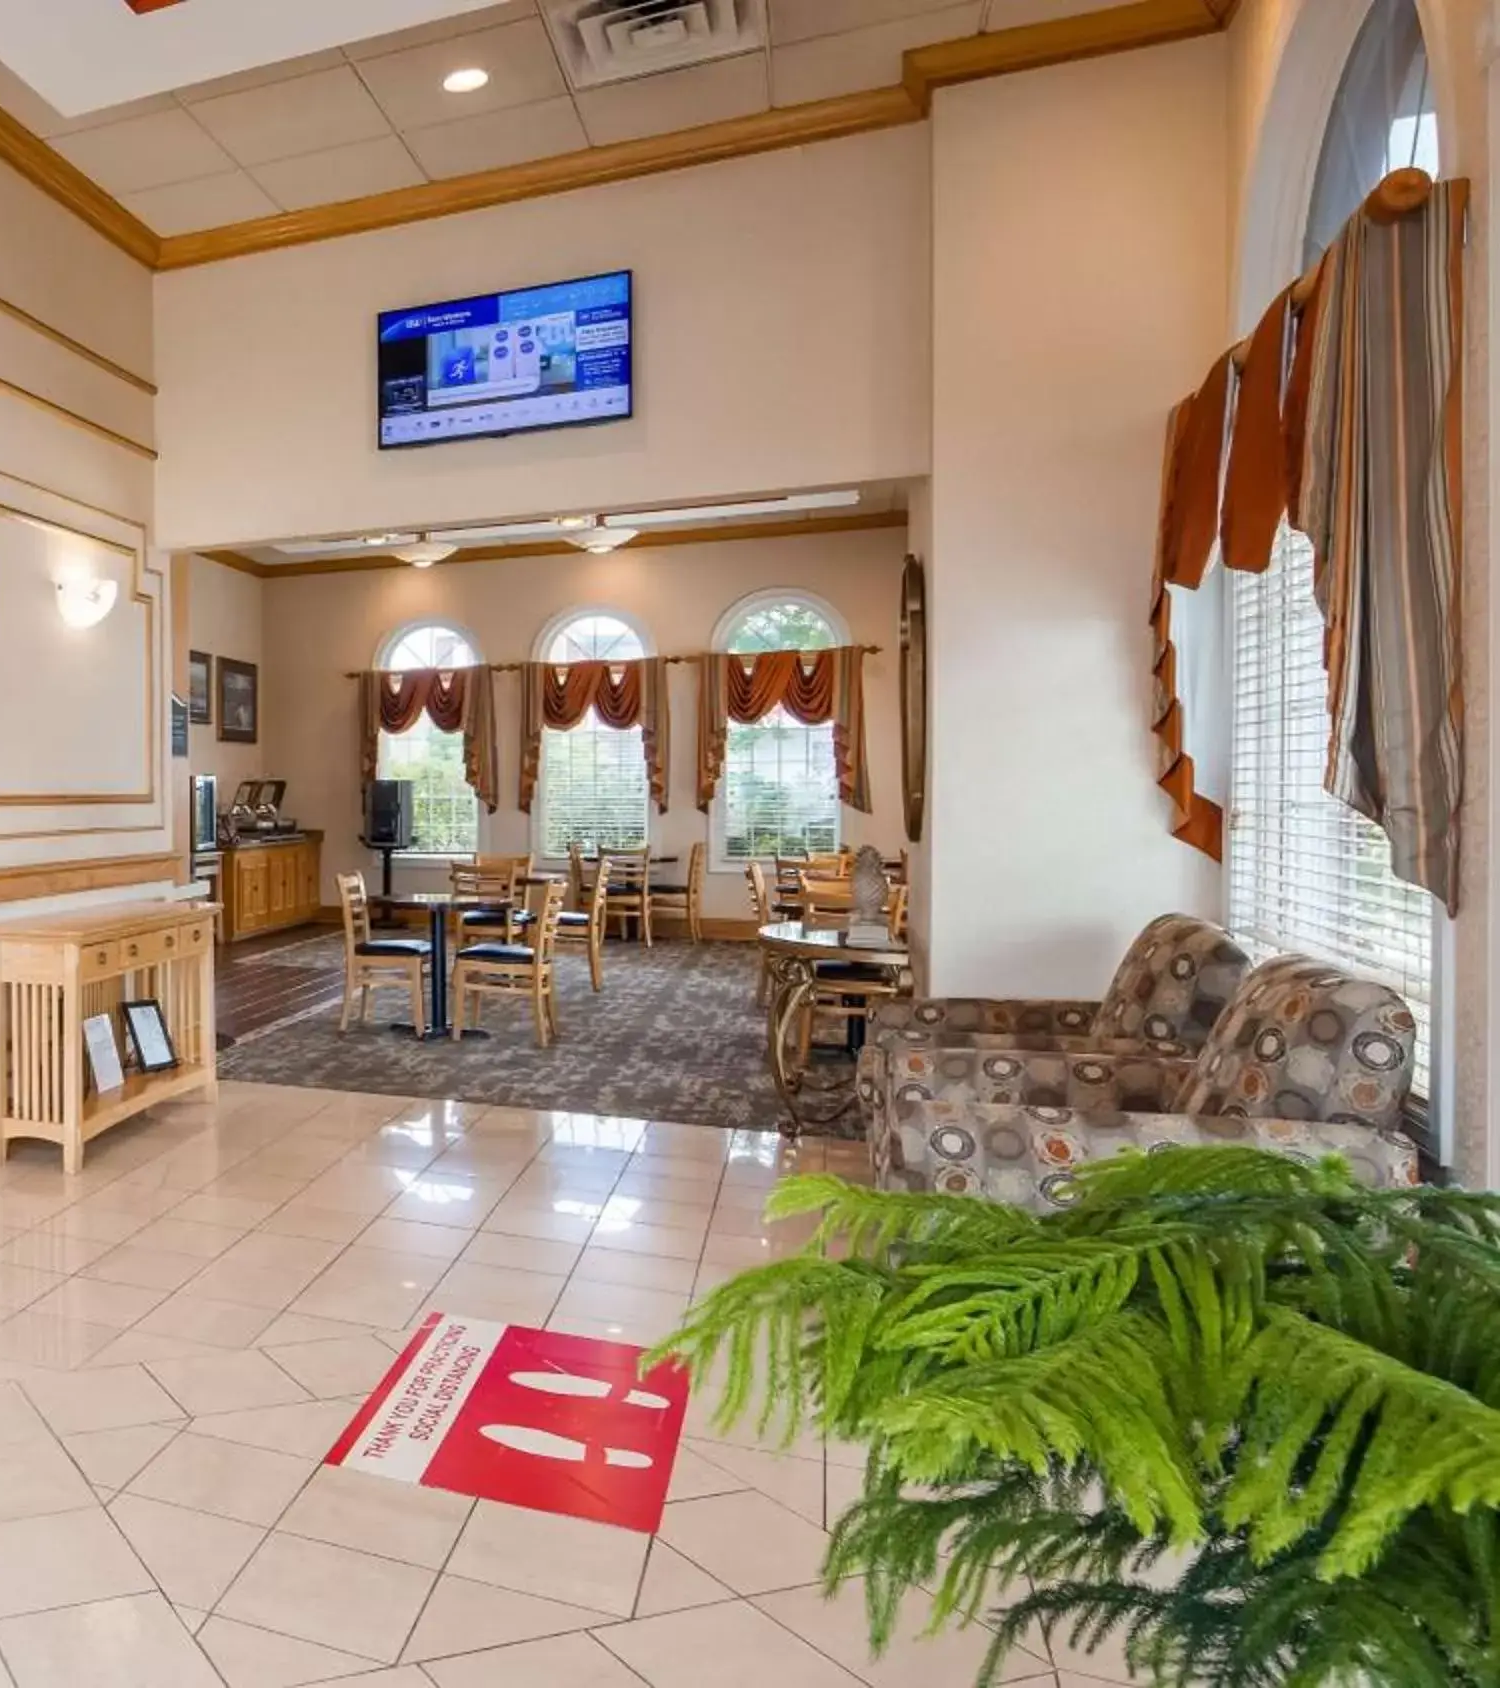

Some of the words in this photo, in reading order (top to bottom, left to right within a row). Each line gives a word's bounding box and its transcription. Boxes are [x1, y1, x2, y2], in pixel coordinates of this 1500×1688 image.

[362, 1420, 404, 1459] THANK
[388, 1397, 419, 1421] YOU
[404, 1375, 434, 1397] FOR
[419, 1324, 467, 1375] PRACTICING
[407, 1401, 448, 1441] SOCIAL
[432, 1344, 481, 1401] DISTANCING
